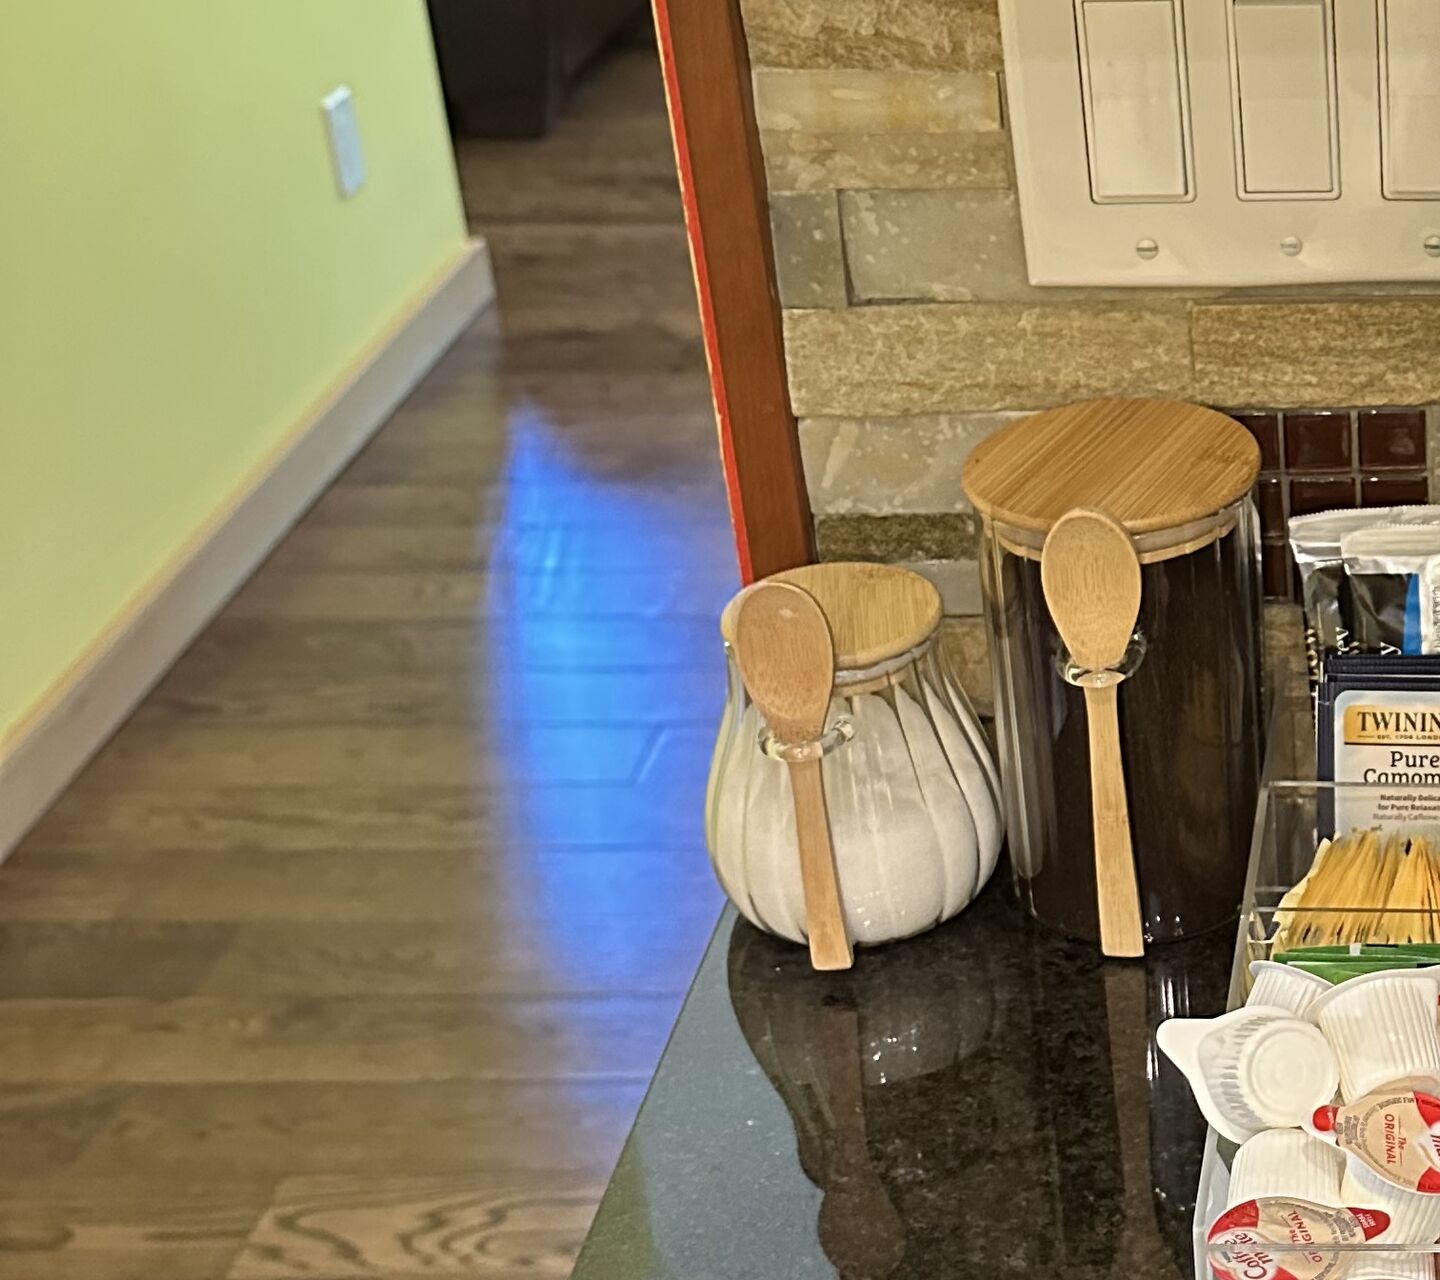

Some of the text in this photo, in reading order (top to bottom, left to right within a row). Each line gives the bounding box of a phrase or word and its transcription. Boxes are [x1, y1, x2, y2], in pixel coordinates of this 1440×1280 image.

[1390, 751, 1440, 768] Pure
[1384, 1113, 1397, 1164] ORIGINAL
[1398, 1136, 1407, 1150] The
[1224, 1238, 1268, 1280] Coffe
[1235, 1232, 1273, 1265] mte
